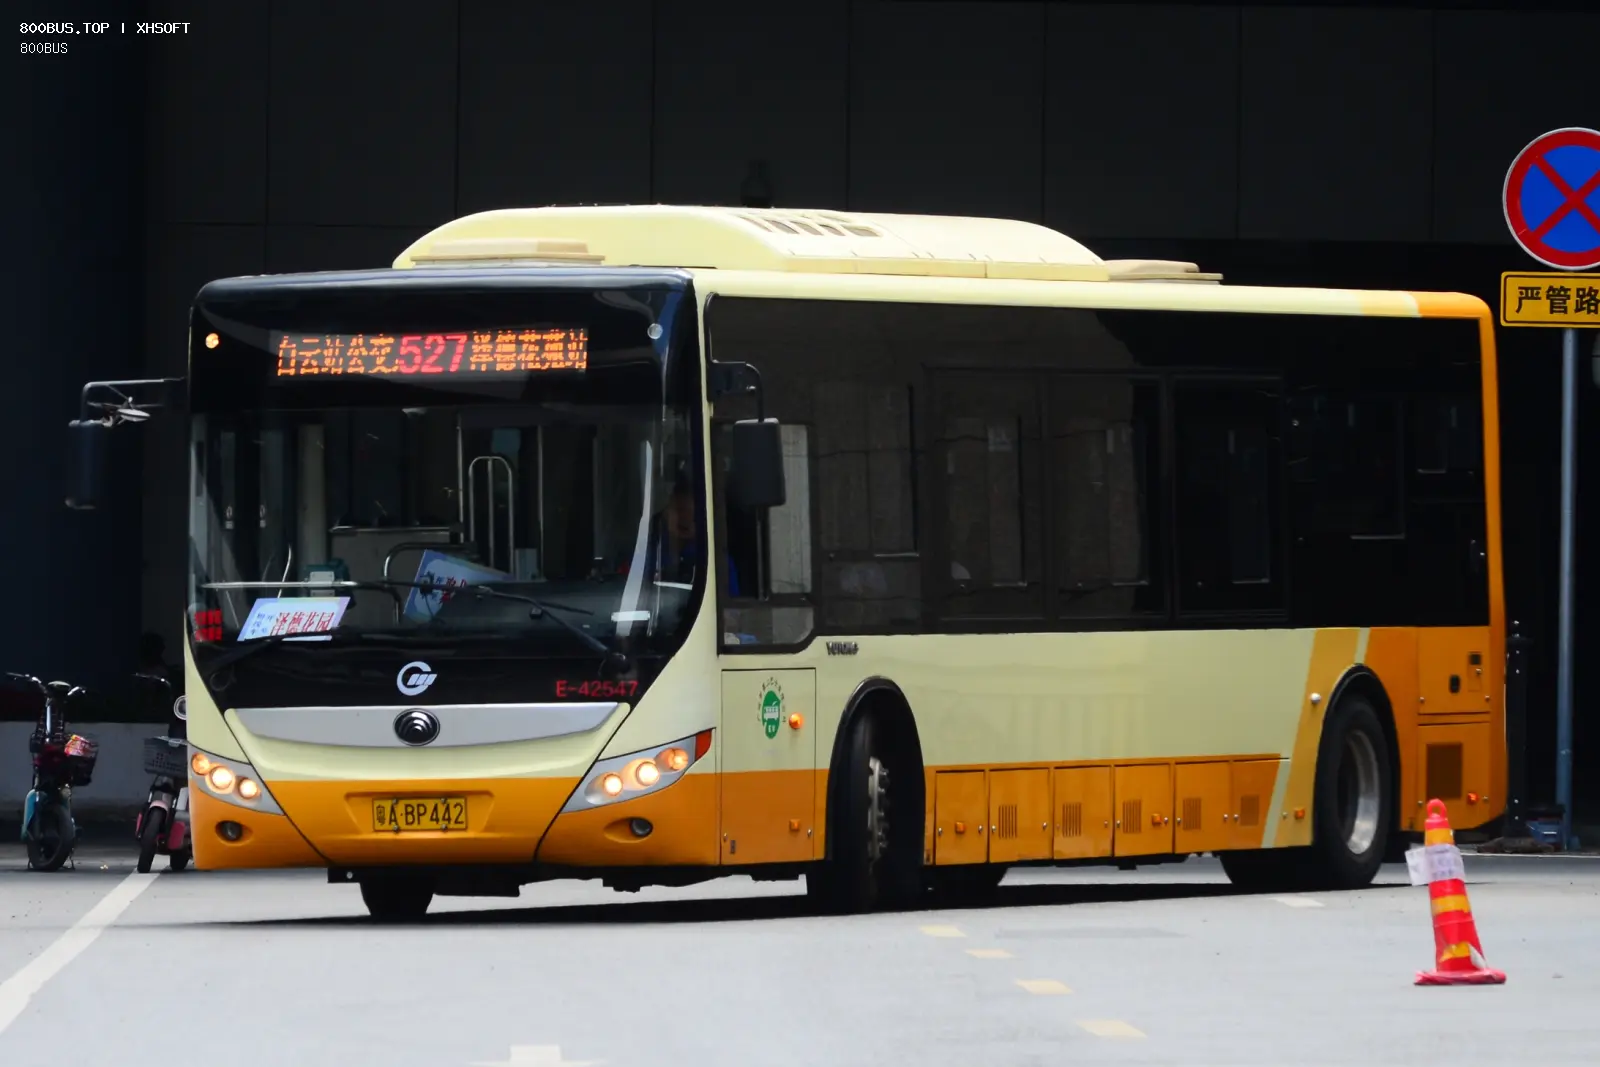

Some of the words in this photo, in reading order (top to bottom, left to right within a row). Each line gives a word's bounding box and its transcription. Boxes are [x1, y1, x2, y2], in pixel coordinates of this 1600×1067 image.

[1515, 285, 1600, 315] 严管路
[399, 333, 468, 374] 527
[555, 680, 639, 697] E-42547
